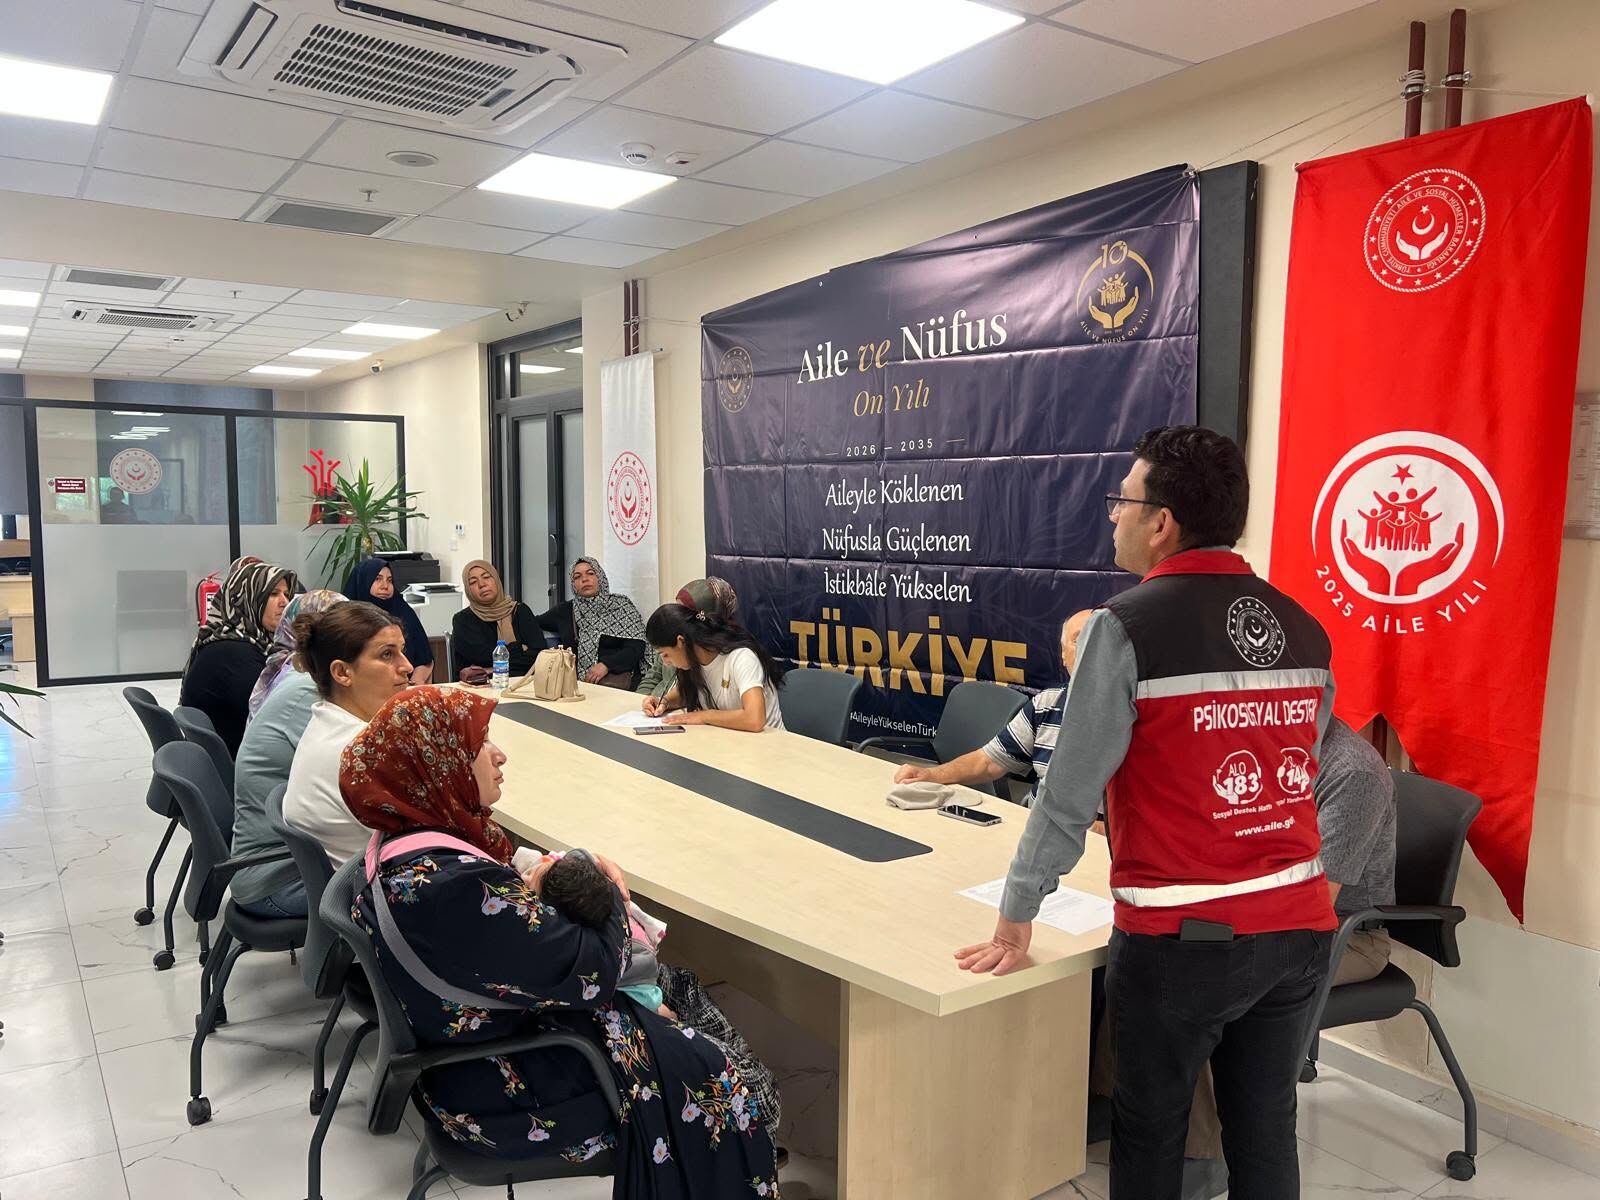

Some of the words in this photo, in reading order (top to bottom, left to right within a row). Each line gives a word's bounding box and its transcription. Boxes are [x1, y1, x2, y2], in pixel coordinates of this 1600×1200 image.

[1101, 240, 1127, 269] 10
[797, 341, 848, 384] Aile
[858, 339, 890, 372] ve
[900, 309, 1007, 363] Nüfus
[854, 390, 884, 417] On
[892, 378, 930, 411] Yılı
[846, 444, 876, 457] 2026
[900, 438, 933, 452] 2035
[825, 477, 877, 514] Aileyle
[880, 473, 964, 504] Köklenen
[822, 523, 882, 559] Nüfusla
[886, 522, 972, 559] Güçlenen
[824, 567, 887, 597] İstikbâle
[890, 570, 973, 603] Yükselen
[1316, 565, 1354, 617] 2025
[1361, 614, 1425, 634] AİLE
[1436, 579, 1488, 622] YILI
[1223, 772, 1260, 795] 183
[1228, 761, 1247, 777] ALO
[1212, 809, 1233, 820] Sosyal
[1233, 804, 1257, 815] Destek
